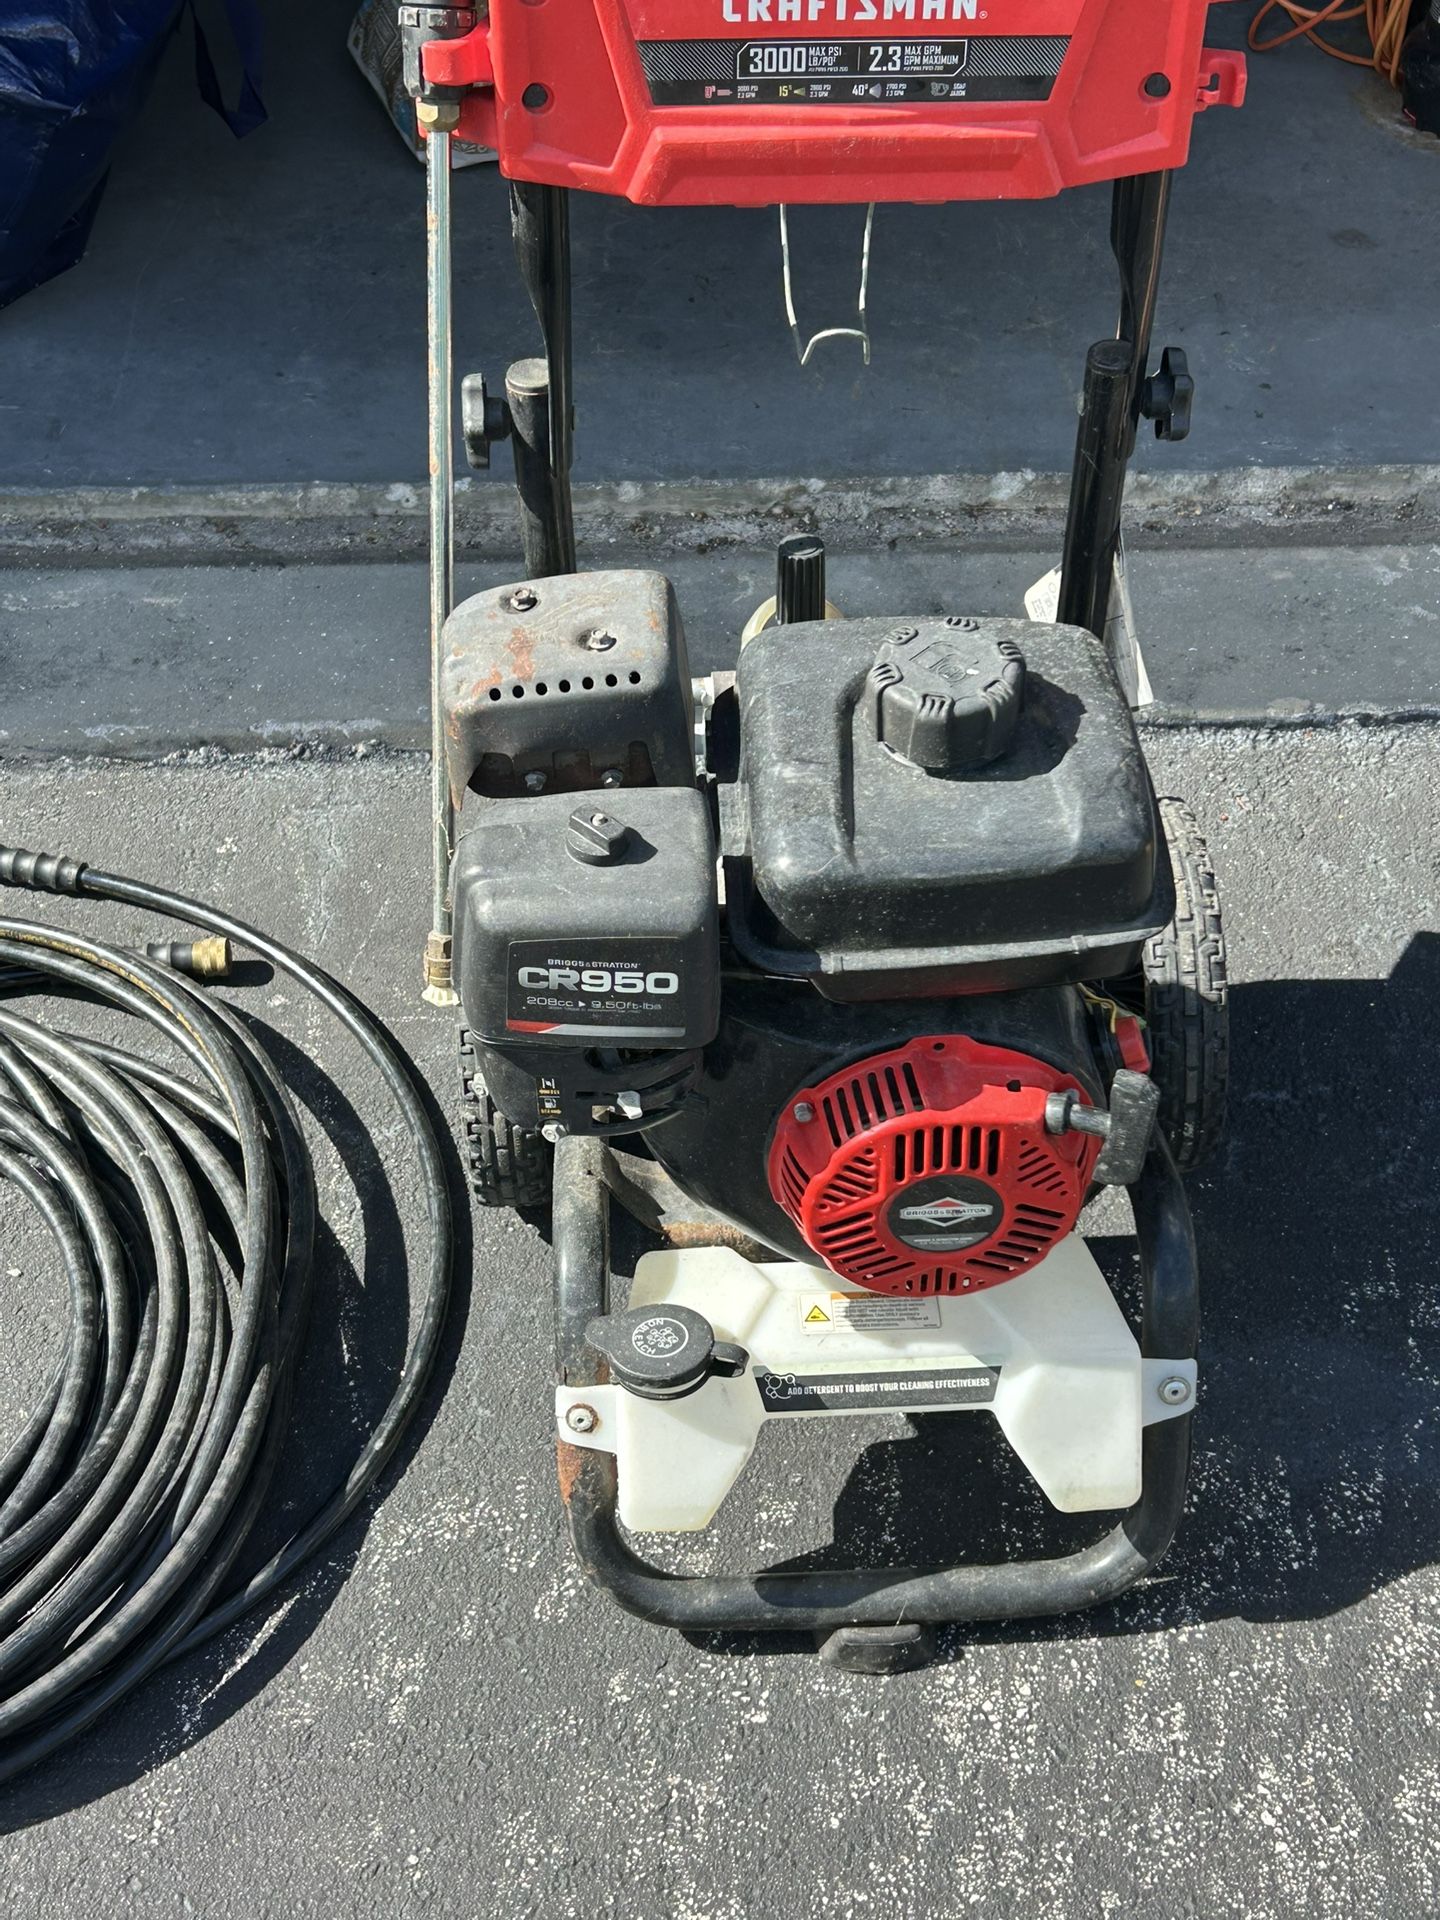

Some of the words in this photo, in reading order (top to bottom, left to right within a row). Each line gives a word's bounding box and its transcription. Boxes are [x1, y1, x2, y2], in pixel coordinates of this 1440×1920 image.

[808, 47, 826, 57] MAX
[828, 46, 842, 57] PSI
[904, 45, 922, 56] MAX
[923, 45, 942, 55] GPM
[749, 47, 807, 73] 3000
[868, 45, 902, 72] 2.3
[903, 56, 921, 66] GPM
[922, 55, 959, 66] MAXIMUM
[547, 958, 585, 968] BRIGGS
[591, 961, 639, 969] STRATTON
[518, 966, 679, 995] CR950
[526, 996, 574, 1008] 208cc
[787, 1387, 803, 1396] ADD
[803, 1384, 844, 1396] DETERGENT
[844, 1384, 855, 1394] TO
[855, 1383, 878, 1393] BOOST
[878, 1381, 899, 1392] YOUR
[899, 1380, 935, 1391] CLEANING
[935, 1377, 990, 1390] EFFECTIVENESS
